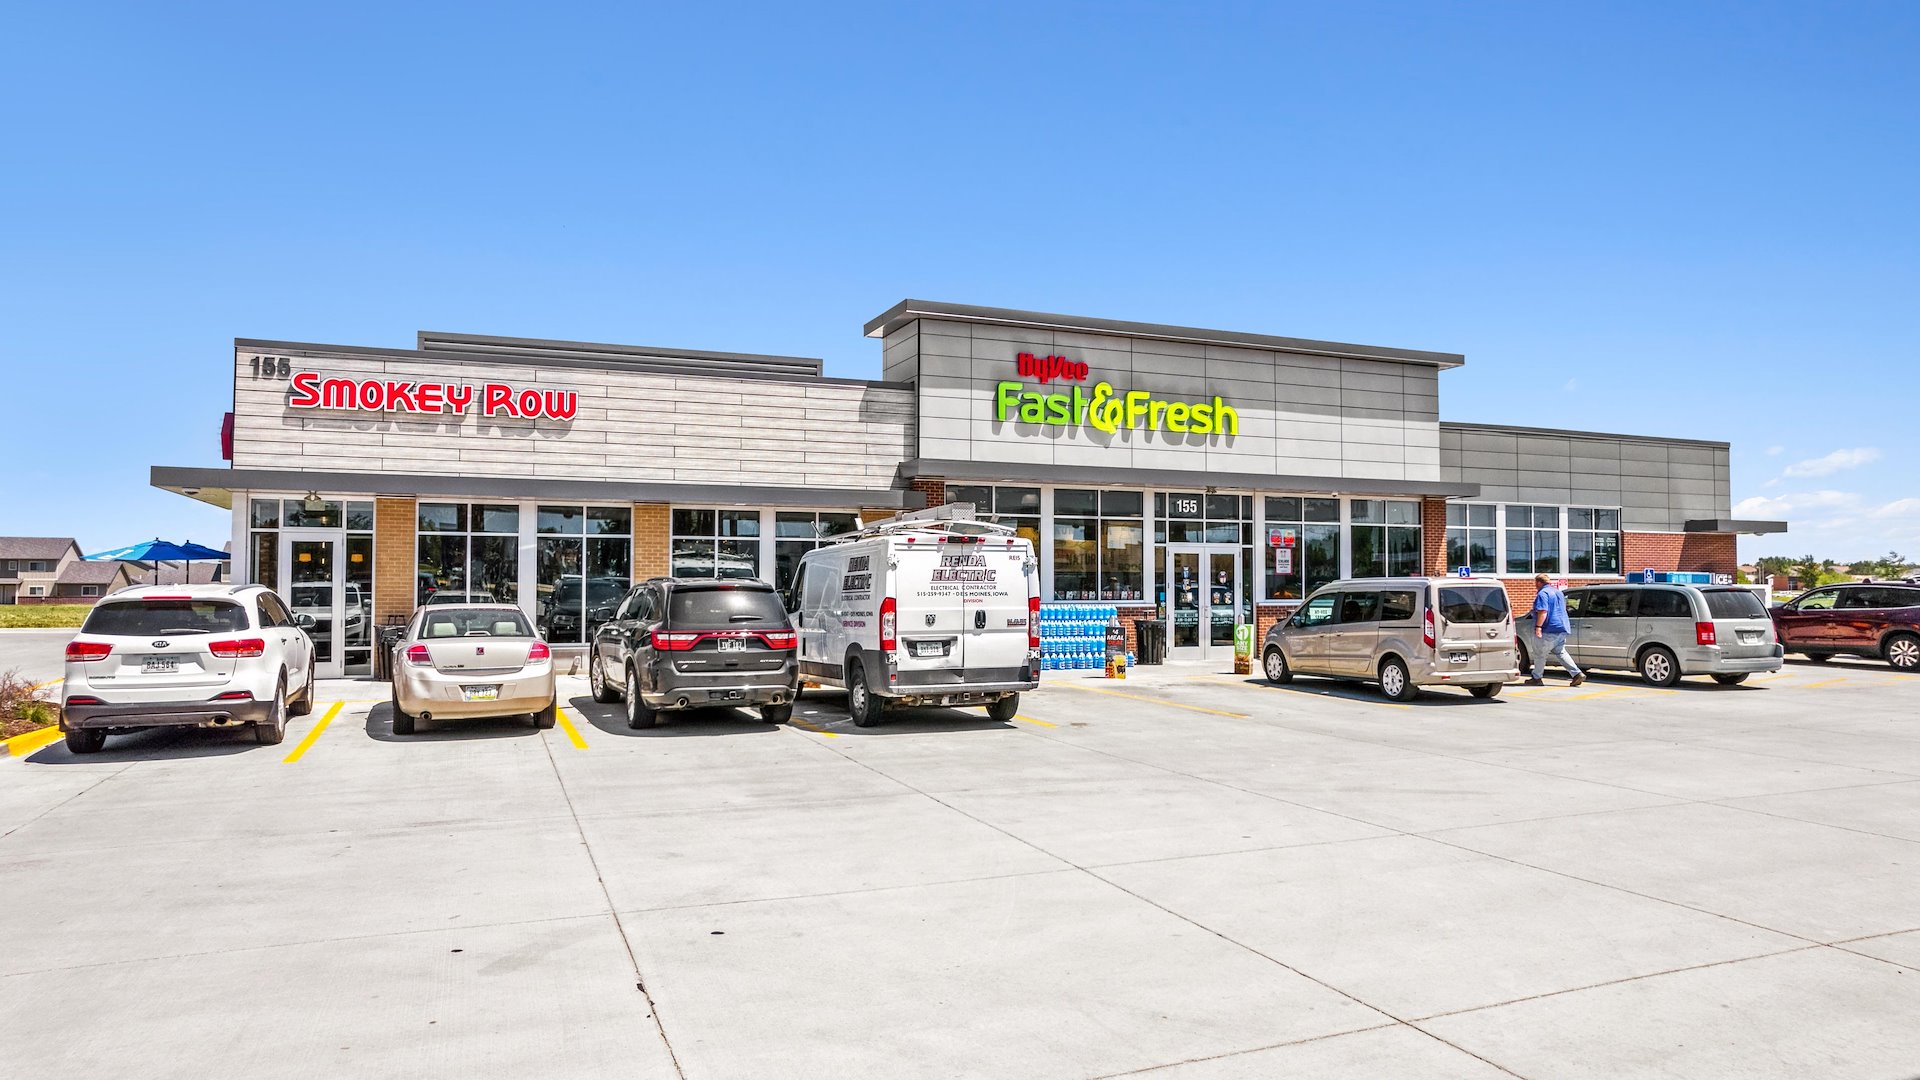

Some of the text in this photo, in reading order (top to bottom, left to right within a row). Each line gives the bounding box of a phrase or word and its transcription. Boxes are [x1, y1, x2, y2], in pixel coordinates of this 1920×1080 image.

[249, 356, 291, 379] 155
[1176, 499, 1198, 513] 155
[848, 555, 870, 573] RENDA
[940, 555, 987, 568] RENDA
[842, 573, 872, 591] ELECTRIC
[931, 568, 997, 582] ELECTRIC
